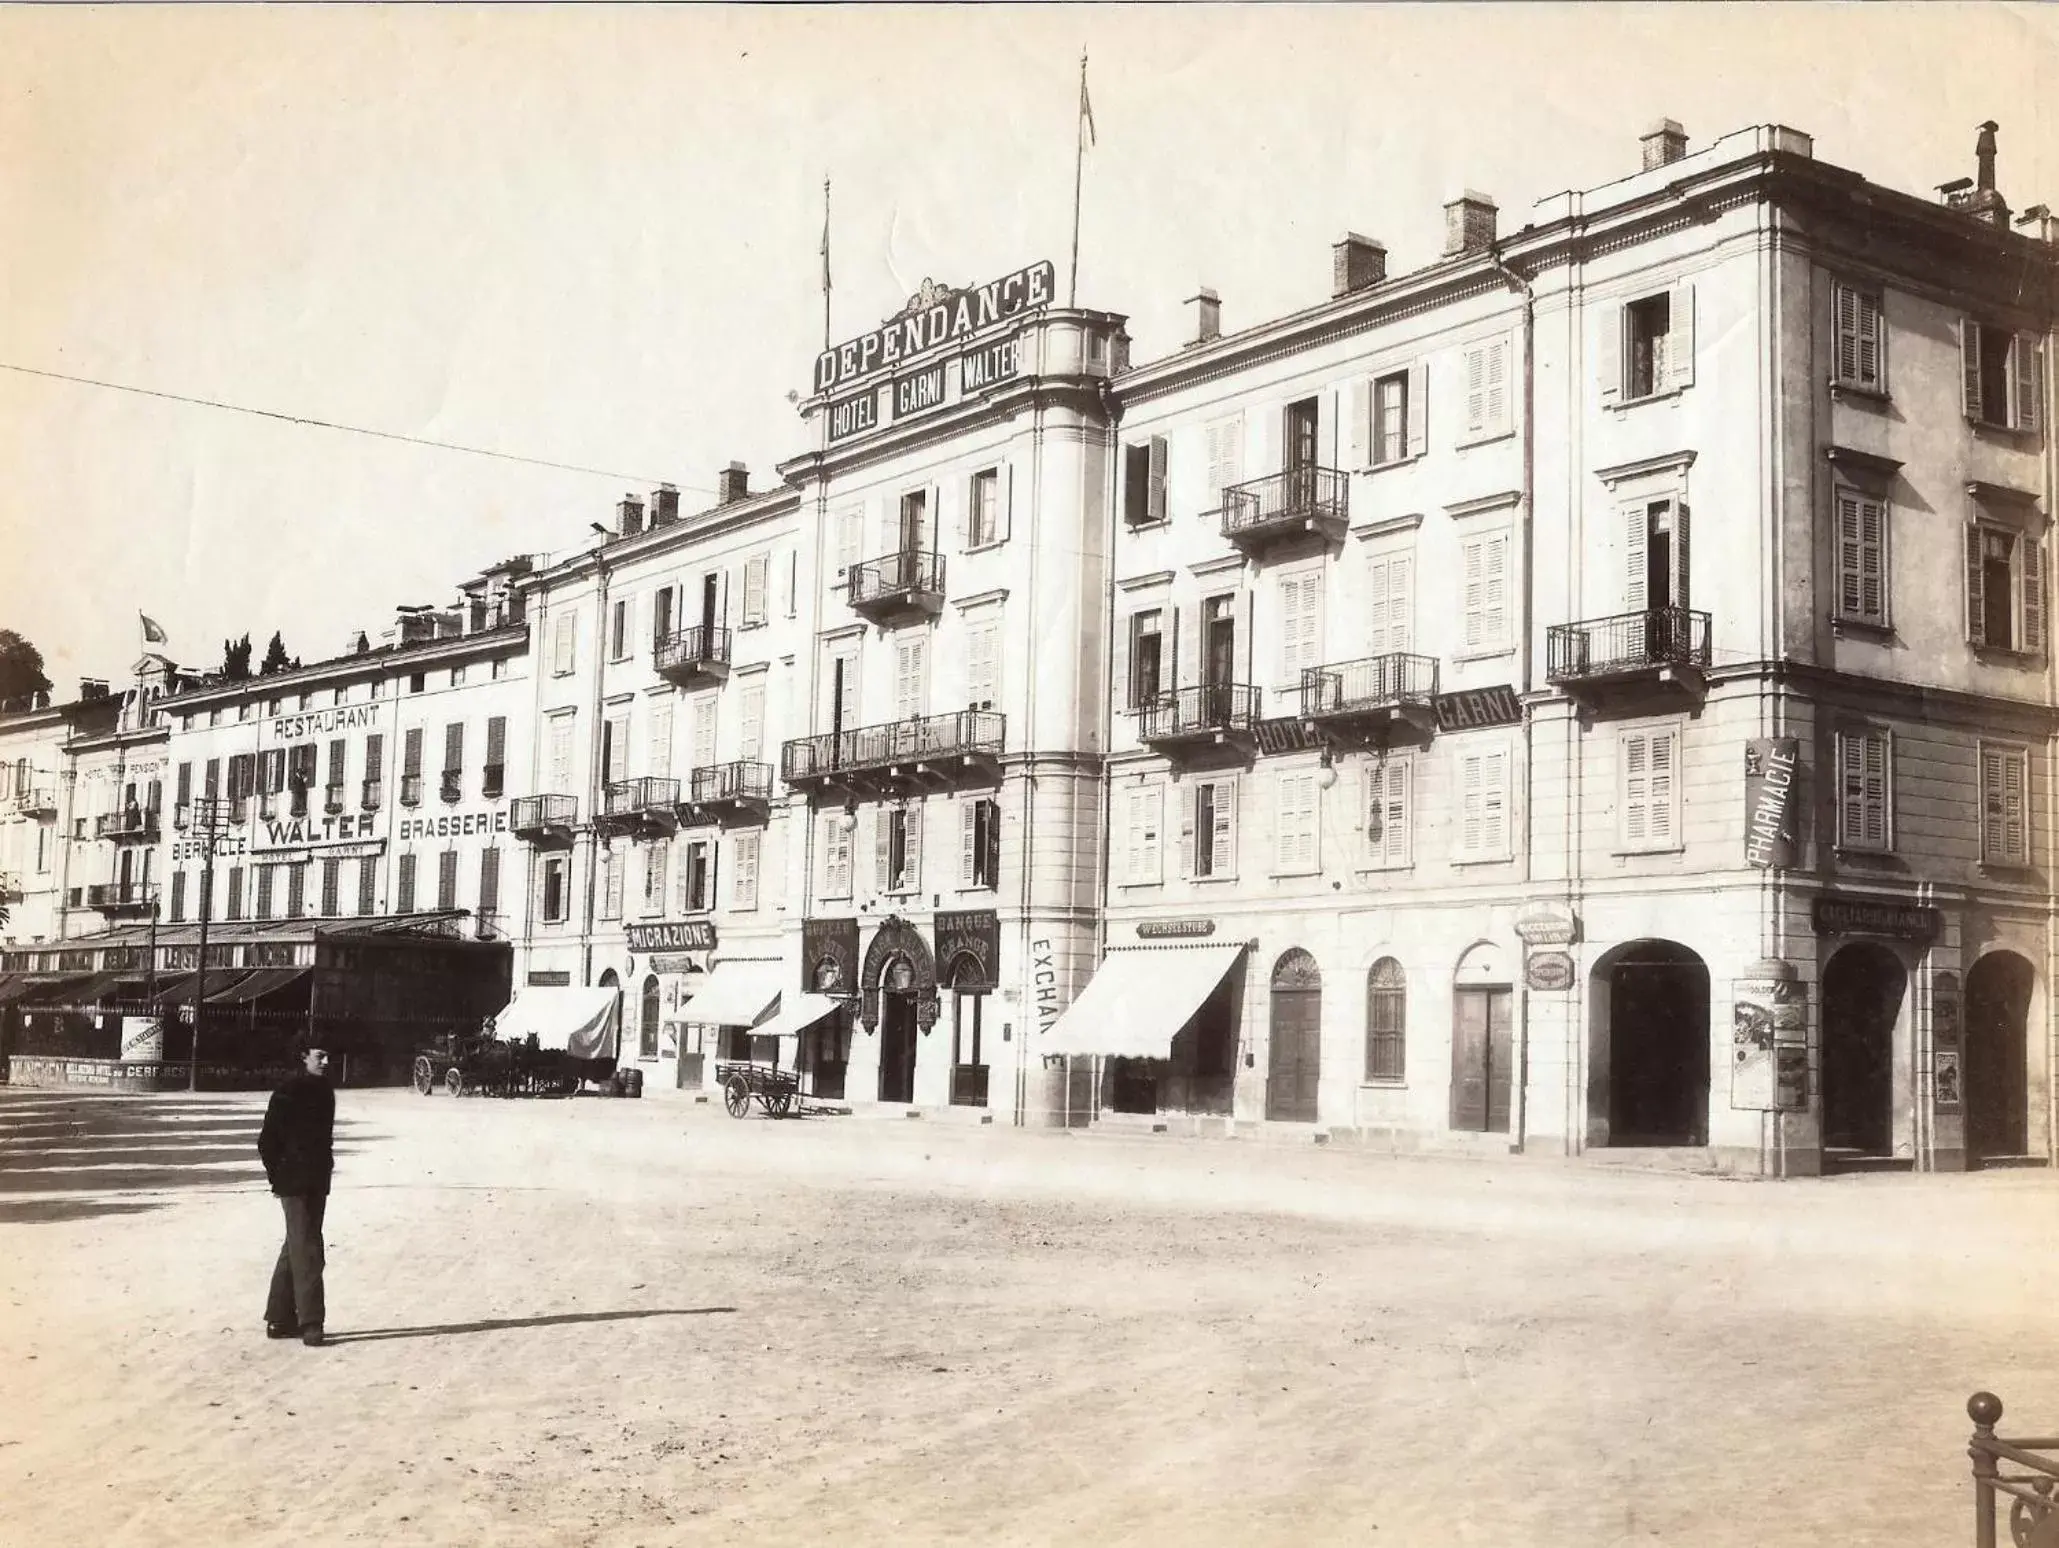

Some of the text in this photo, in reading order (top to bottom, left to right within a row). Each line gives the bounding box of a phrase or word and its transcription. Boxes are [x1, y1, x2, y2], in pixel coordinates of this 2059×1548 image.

[818, 262, 1049, 389] DEPENDANCE
[834, 339, 1021, 437] HOTEL GARNI WALTER
[274, 705, 379, 740] RESTAURANT
[1435, 690, 1517, 728] GARNI
[1747, 748, 1796, 864] PHARMACIE
[266, 814, 374, 845] WALTER
[400, 811, 507, 840] BRASSERIE
[937, 912, 993, 937] BANQUE
[1032, 938, 1065, 1070] EXCHANE
